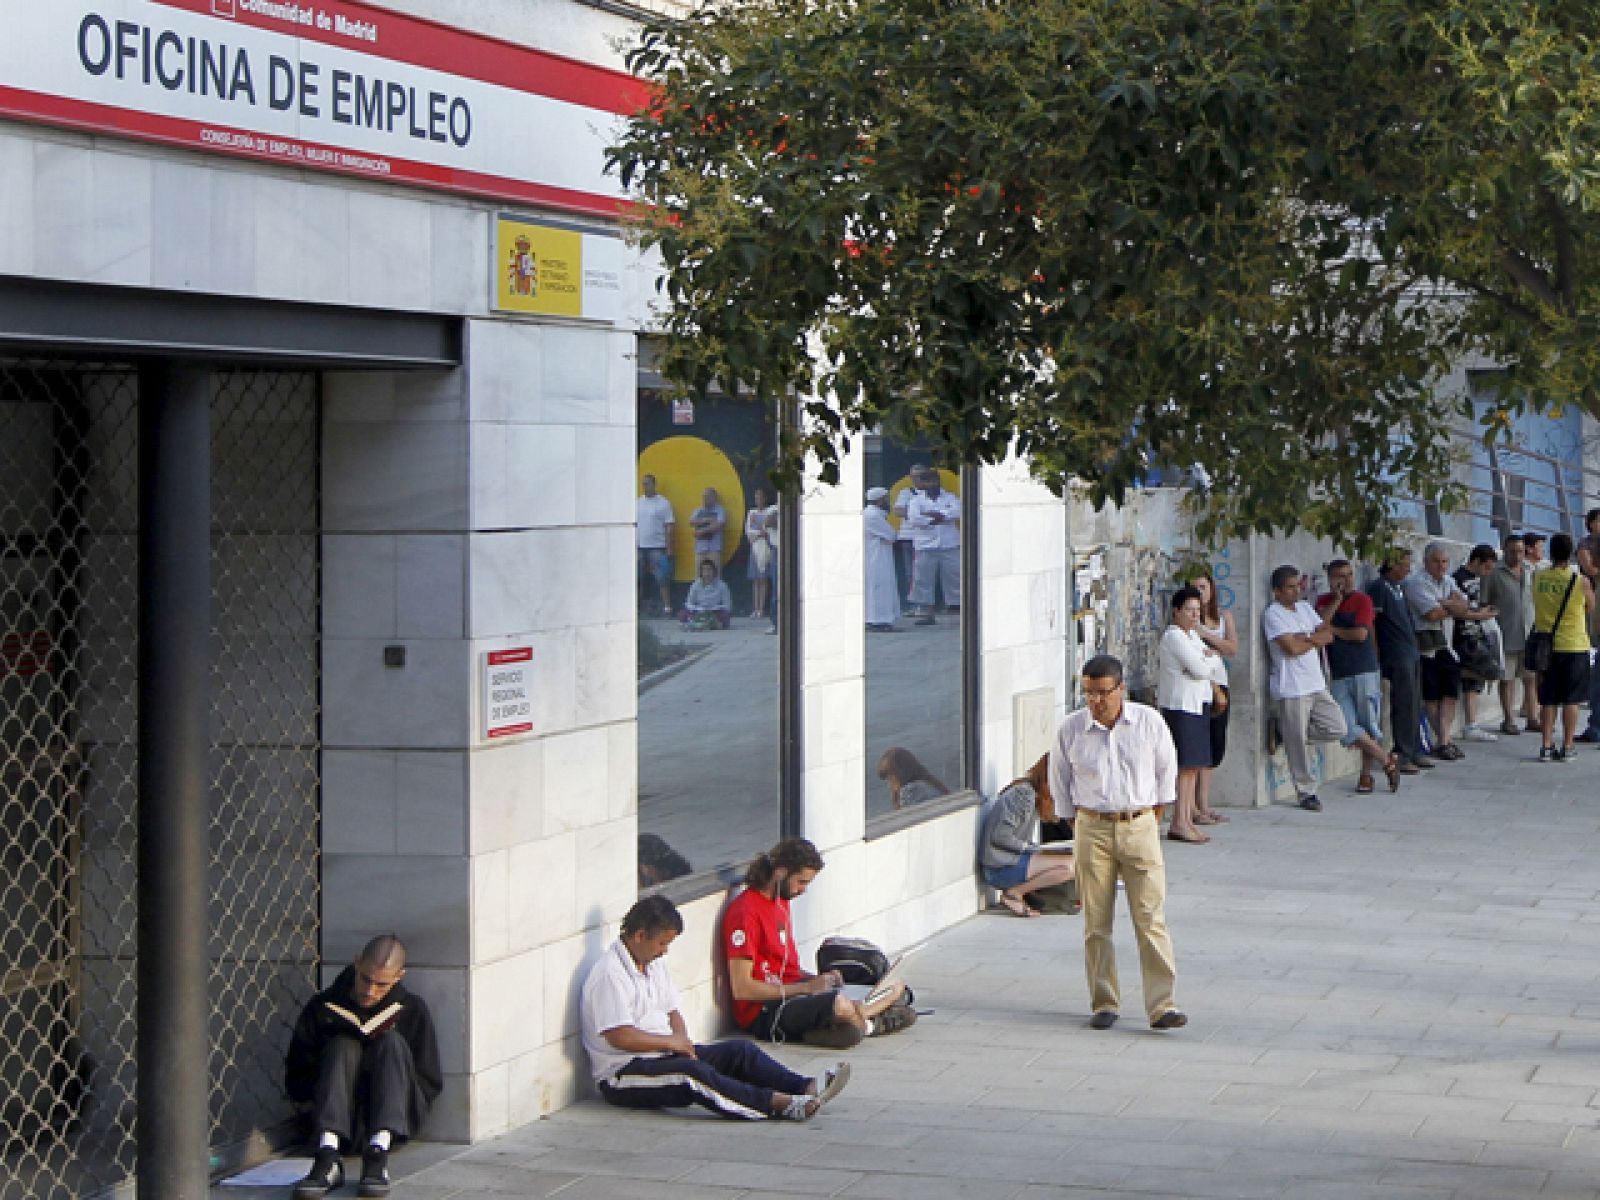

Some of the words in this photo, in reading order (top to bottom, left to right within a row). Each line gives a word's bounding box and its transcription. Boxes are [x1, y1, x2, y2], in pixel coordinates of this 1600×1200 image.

[239, 0, 313, 25] Comunidad
[317, 10, 331, 31] de
[335, 14, 377, 42] Madrid
[78, 13, 256, 105] OFICINA
[269, 54, 320, 118] DE
[332, 69, 471, 147] EMPLEO
